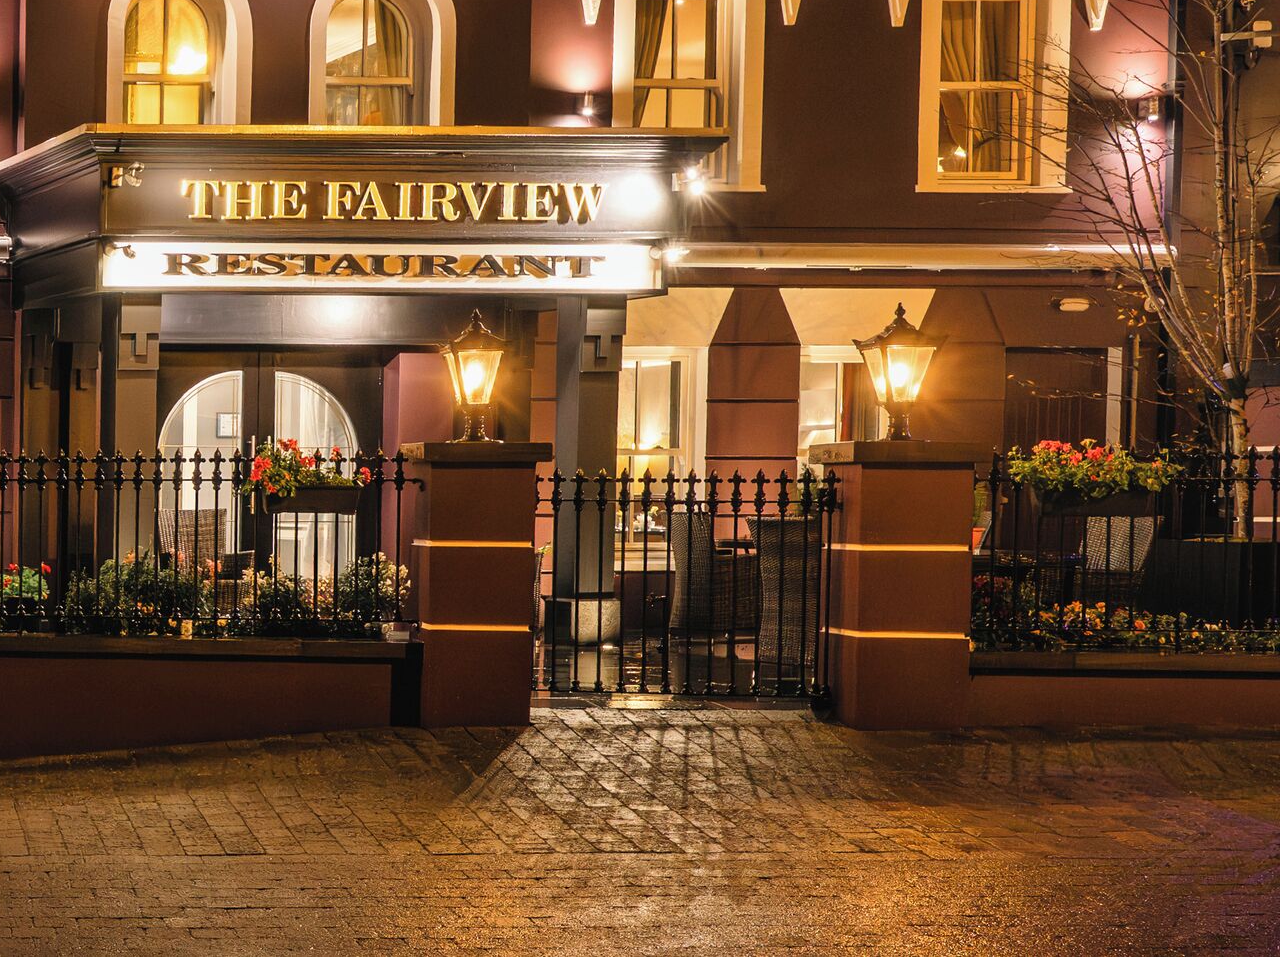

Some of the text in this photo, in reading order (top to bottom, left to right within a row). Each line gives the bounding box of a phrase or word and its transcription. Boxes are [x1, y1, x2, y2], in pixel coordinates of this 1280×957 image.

[181, 179, 608, 222] THE FAIRVIEW
[162, 254, 606, 278] RESTAURANT
